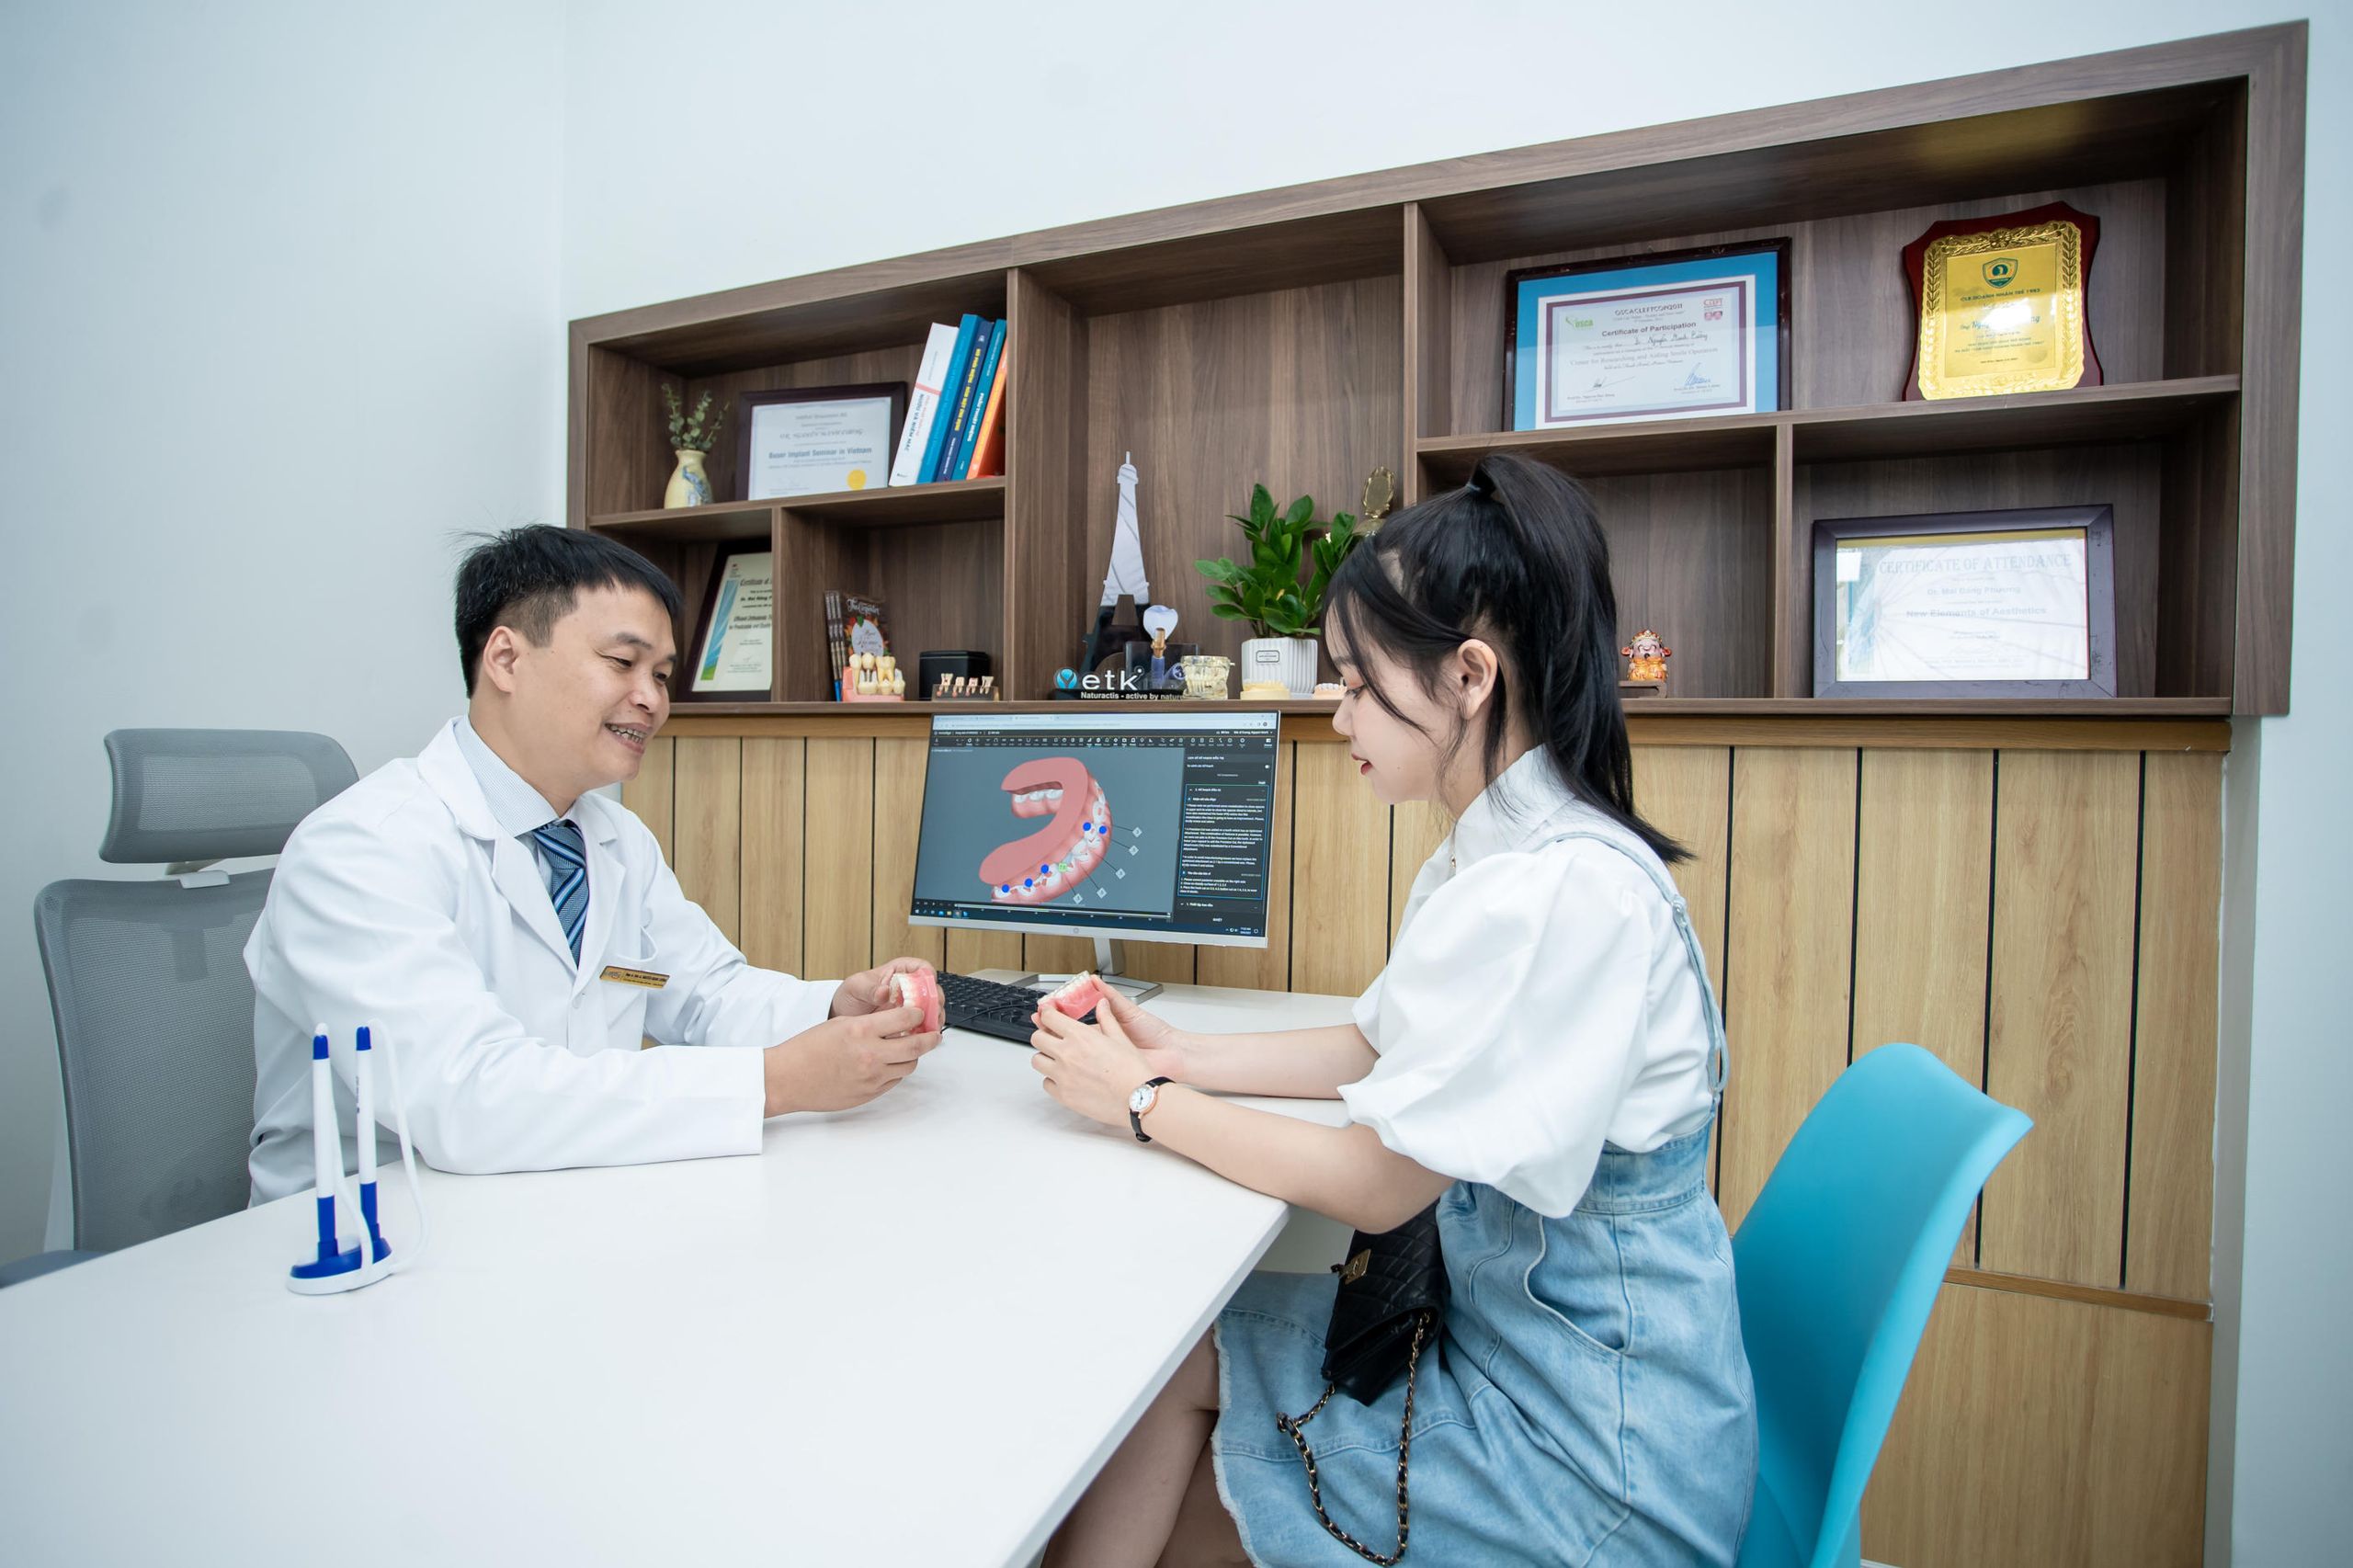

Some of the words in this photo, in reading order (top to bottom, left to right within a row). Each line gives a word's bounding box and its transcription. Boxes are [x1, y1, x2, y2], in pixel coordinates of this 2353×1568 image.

[1601, 327, 1639, 337] Certificate
[1650, 322, 1697, 333] Participation
[1878, 559, 1961, 574] CERTIFICATE
[1963, 558, 1979, 571] OF
[1984, 554, 2072, 570] ATTENDANCE
[1930, 608, 1976, 618] Elements
[1980, 608, 1990, 616] of
[1992, 606, 2047, 616] Aesthetics
[1082, 668, 1139, 690] etk
[1126, 691, 1148, 699] active
[1149, 691, 1159, 701] by
